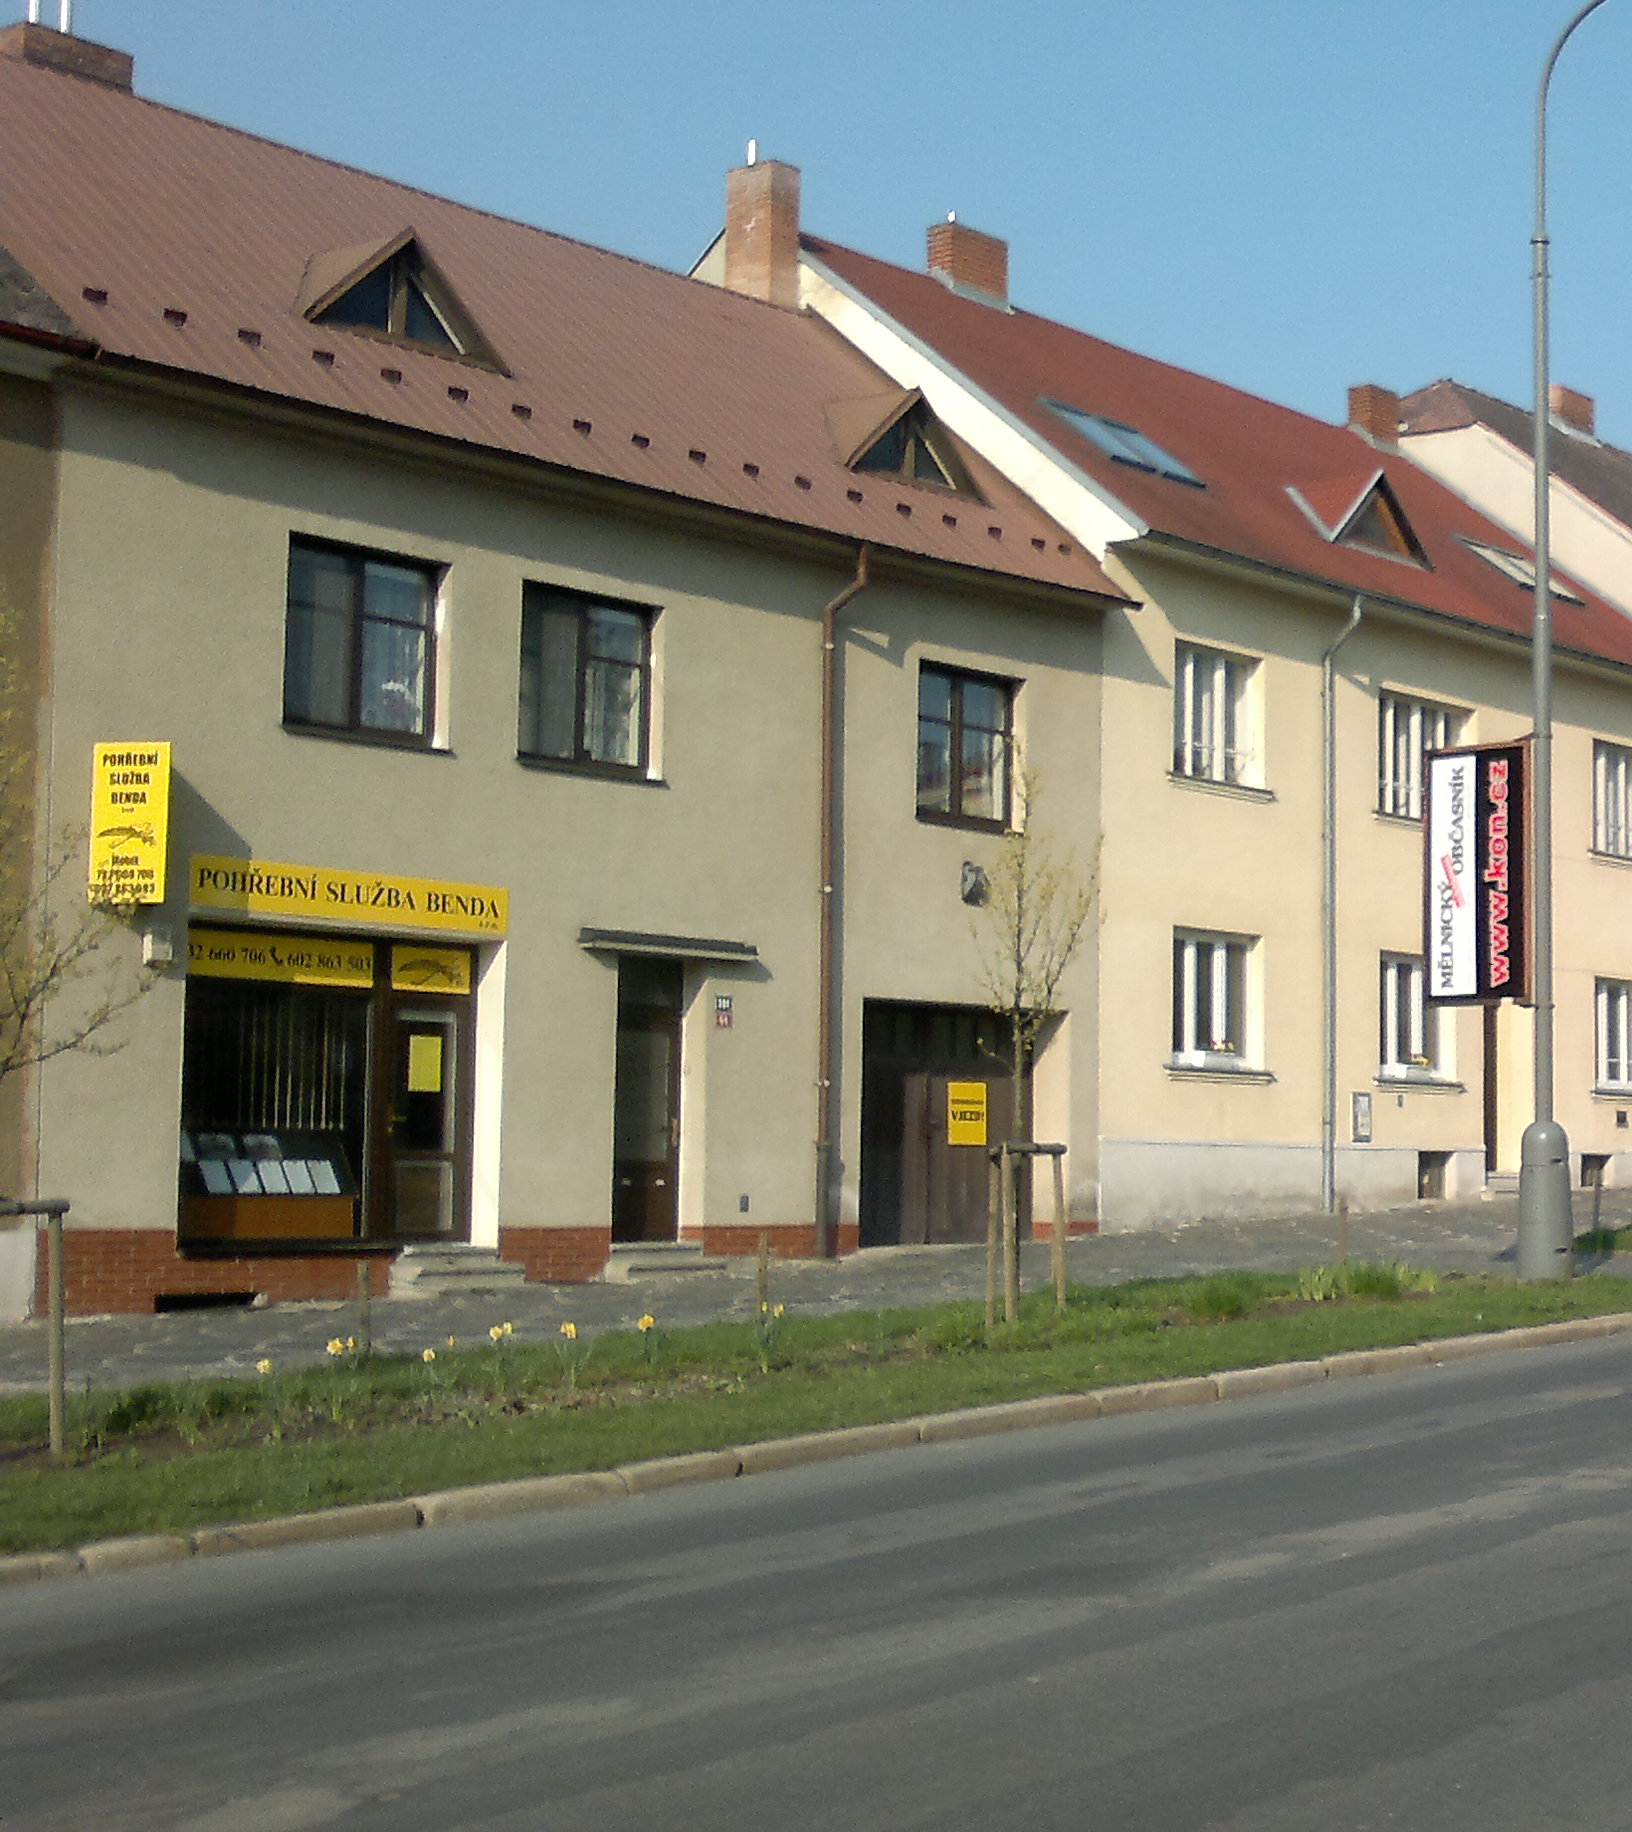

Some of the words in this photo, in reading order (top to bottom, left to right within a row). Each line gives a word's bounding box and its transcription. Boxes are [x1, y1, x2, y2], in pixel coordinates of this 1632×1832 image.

[102, 751, 158, 767] POHŘEBNÍ
[109, 772, 150, 786] SLUŽBA
[111, 791, 147, 805] BENDA
[1448, 765, 1465, 875] OBČASNÍK
[1484, 759, 1510, 988] www.kon.cz
[199, 867, 318, 901] POHŘEBNÍ
[325, 880, 416, 912] SLUŽBA
[426, 891, 500, 919] BENDA
[1437, 880, 1455, 989] MĚLNICKÝ
[241, 946, 266, 965] 706
[287, 952, 313, 969] 602
